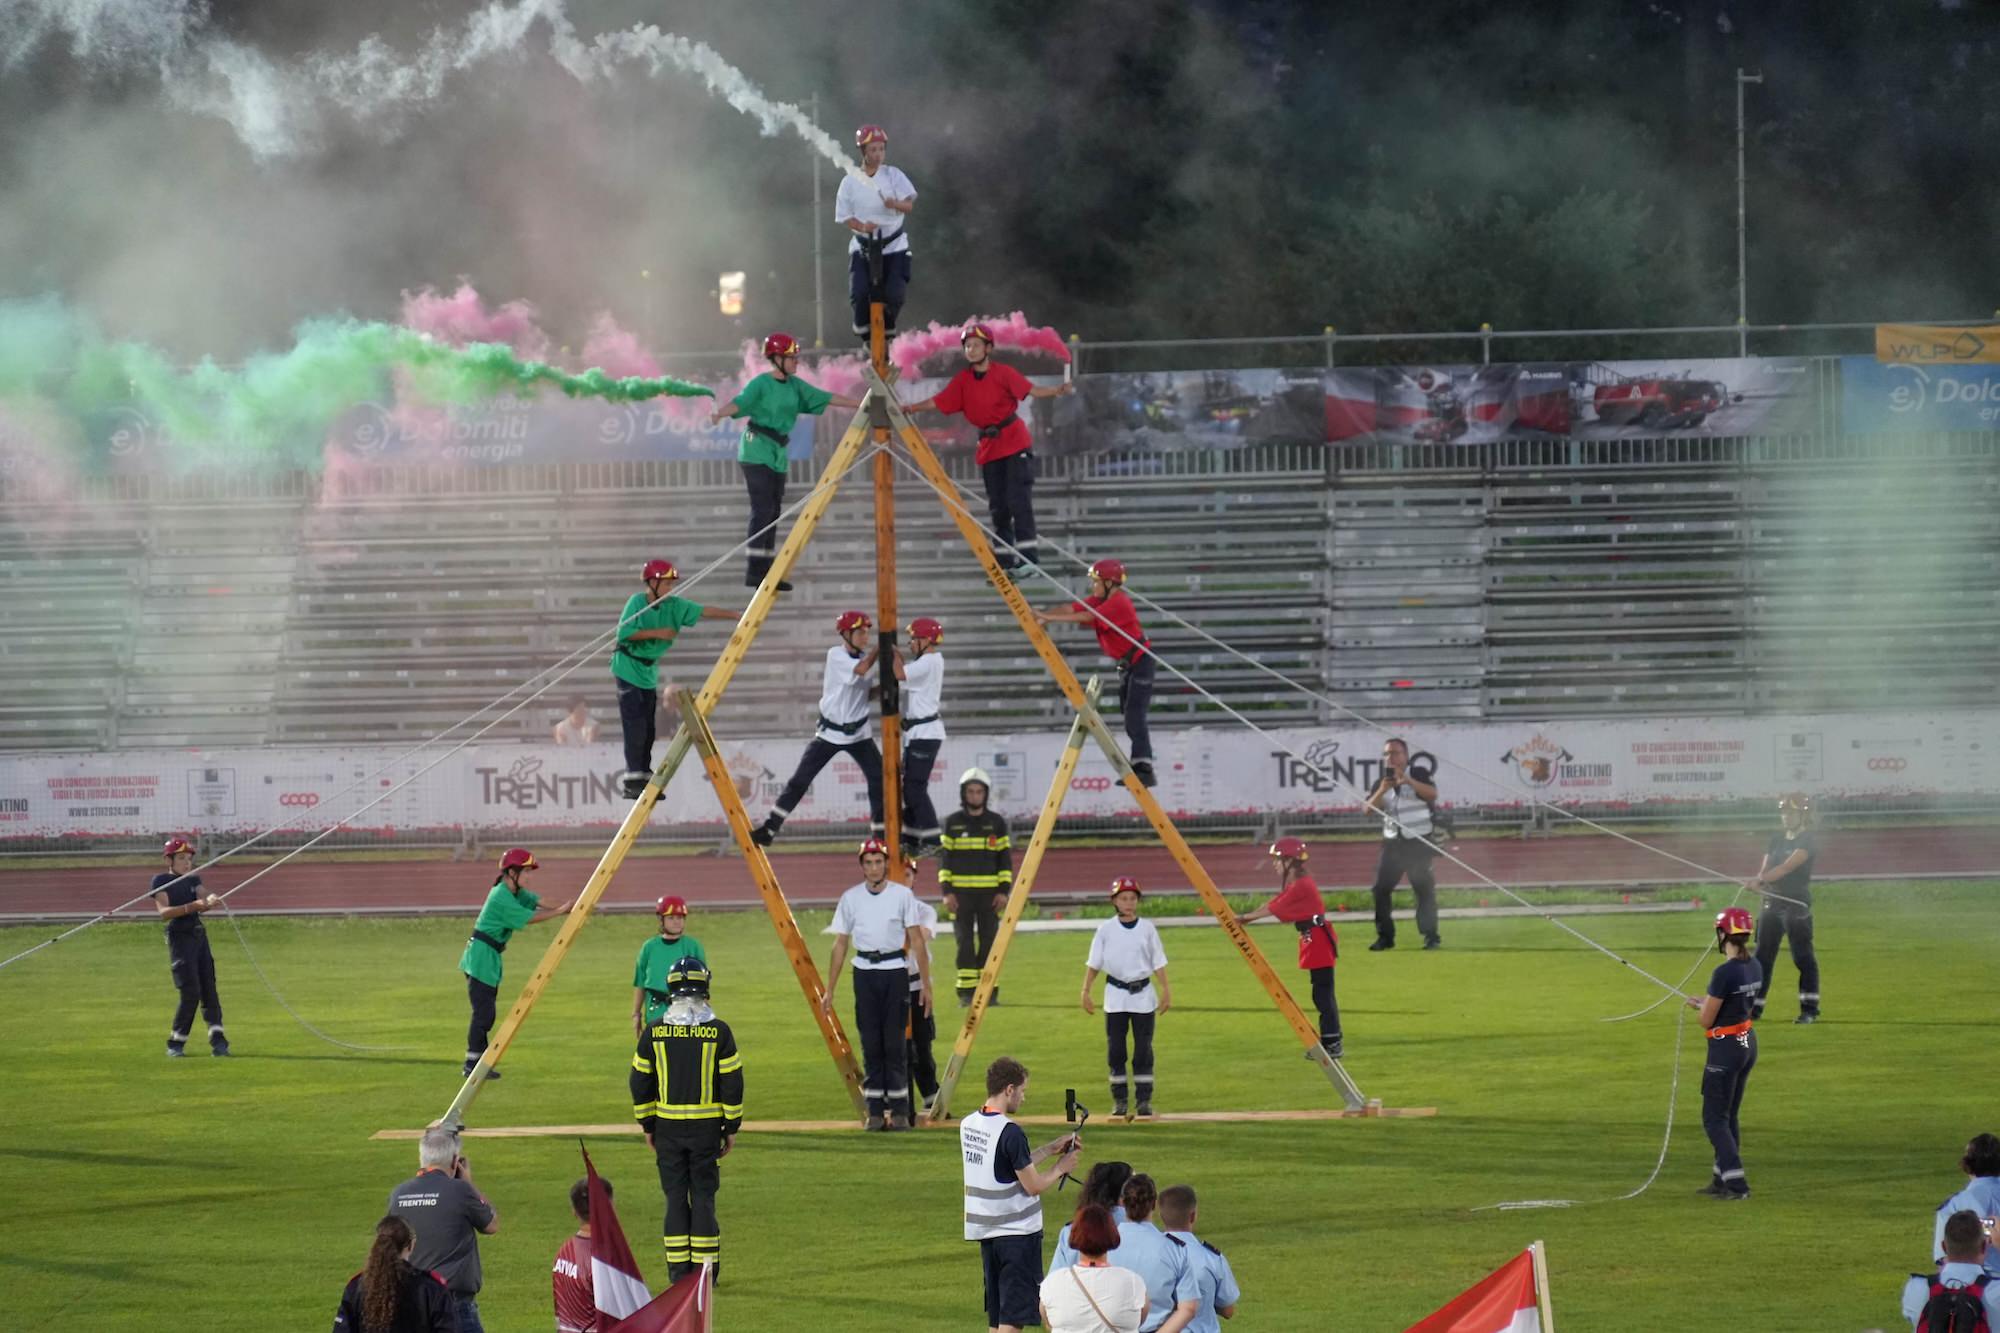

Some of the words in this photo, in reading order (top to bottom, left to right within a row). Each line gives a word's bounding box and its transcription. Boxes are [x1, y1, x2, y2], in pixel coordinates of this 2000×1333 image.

[1560, 764, 1612, 778] TRENTINO
[1071, 777, 1111, 792] coop
[280, 793, 319, 808] coop
[651, 1025, 672, 1038] VIGILI
[673, 1025, 689, 1038] DEL
[689, 1025, 718, 1039] FUOCO
[398, 1199, 437, 1207] TRENTINO
